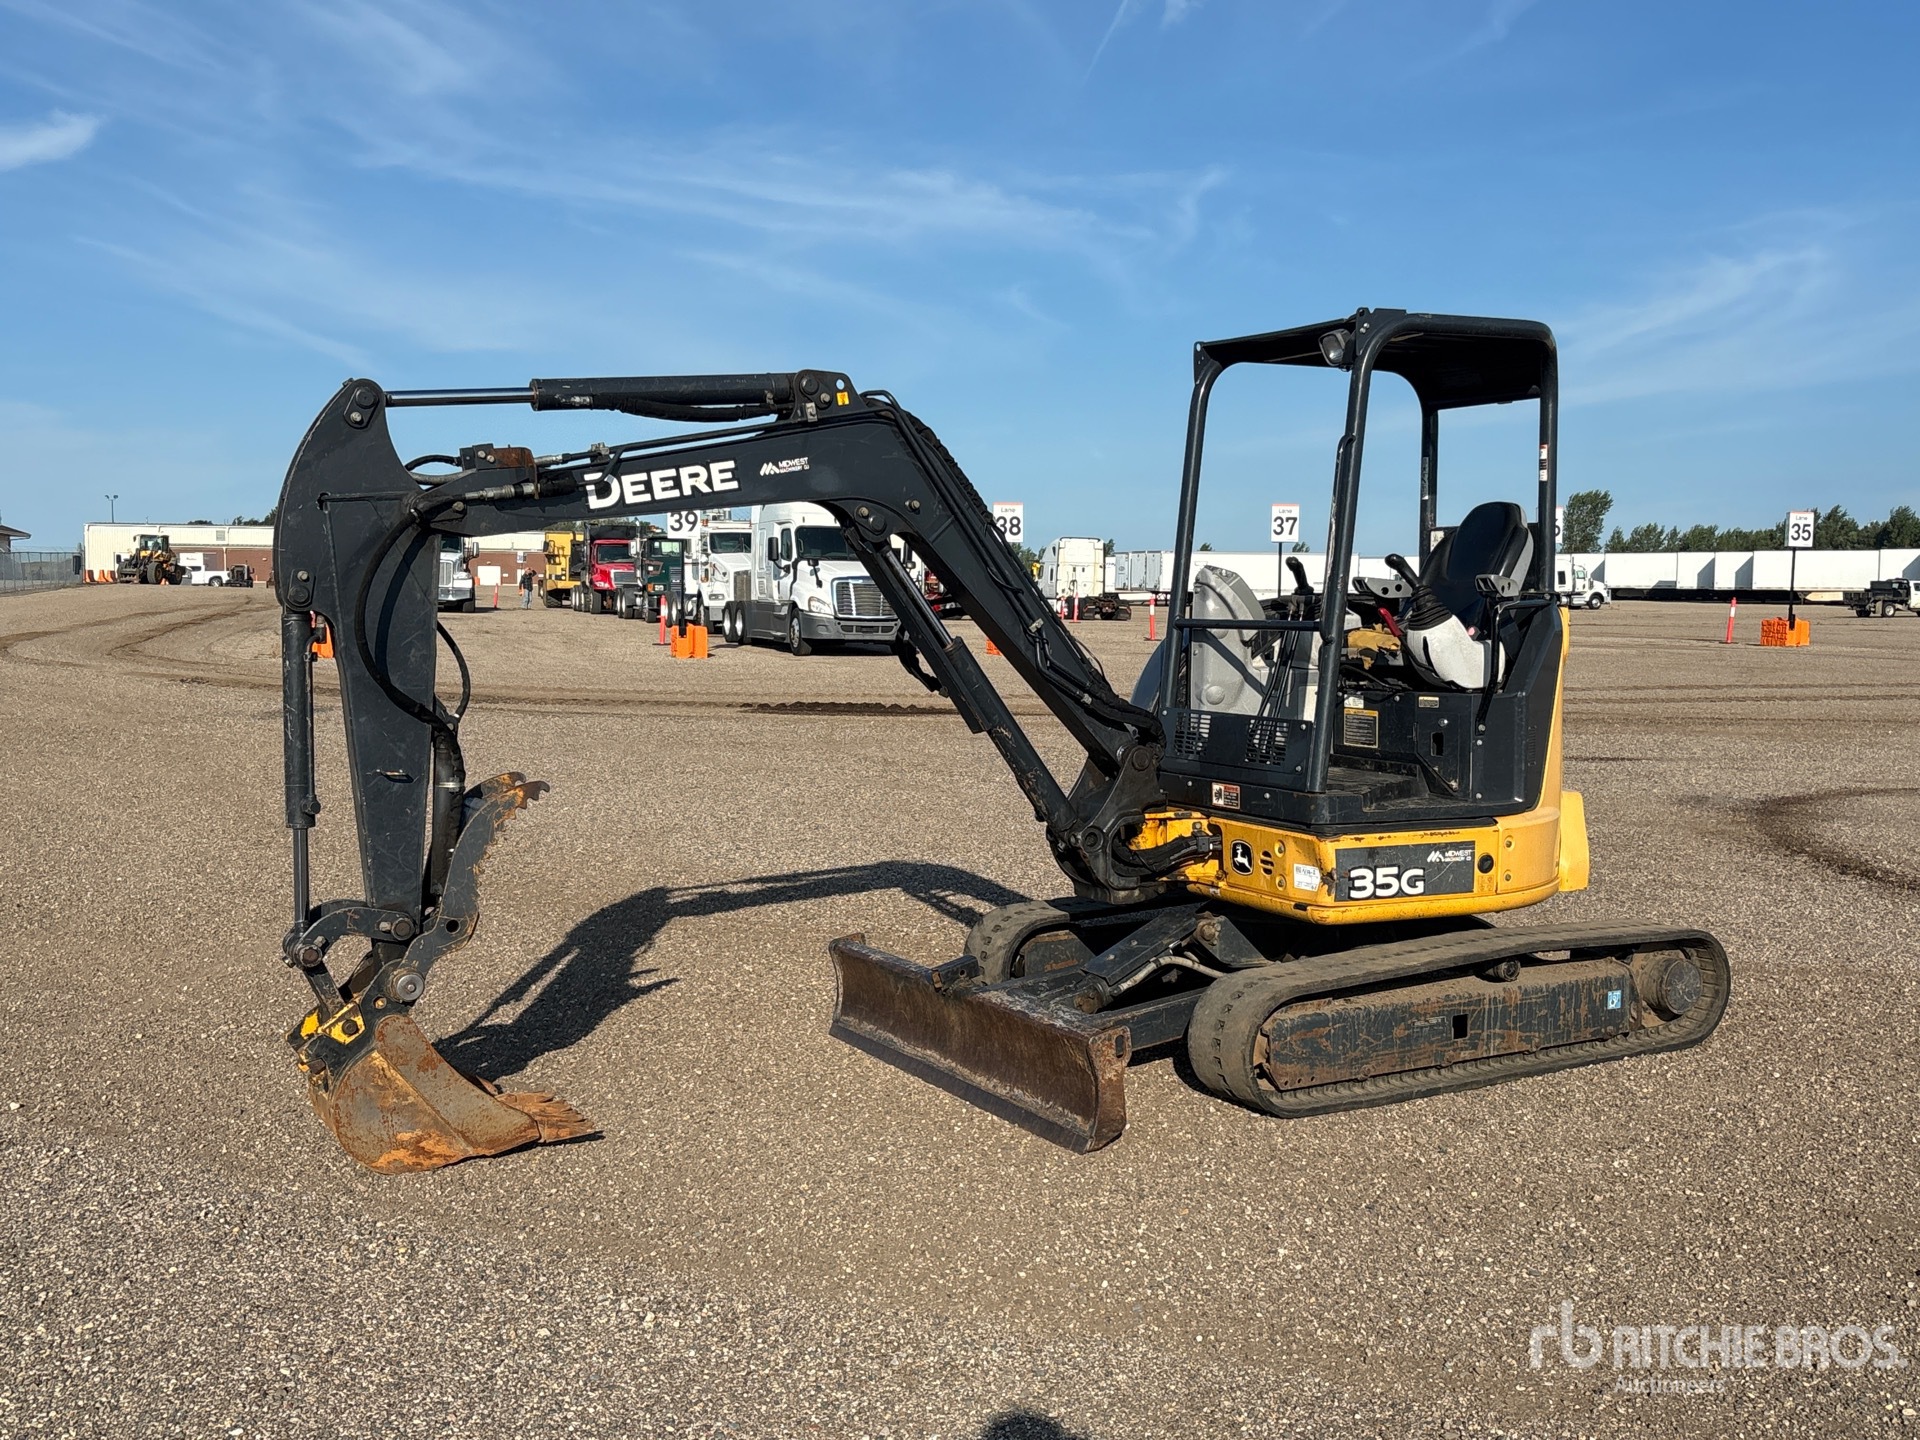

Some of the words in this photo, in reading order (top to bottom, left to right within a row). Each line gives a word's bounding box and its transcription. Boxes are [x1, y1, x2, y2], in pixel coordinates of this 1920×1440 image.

[778, 457, 809, 468] MIDWEST
[584, 460, 739, 510] DEERE
[670, 511, 699, 532] 39
[996, 516, 1021, 536] 38
[1273, 516, 1298, 536] 37
[1791, 523, 1811, 541] 35
[1444, 849, 1473, 857] MIDWEST
[1349, 866, 1425, 899] 35G
